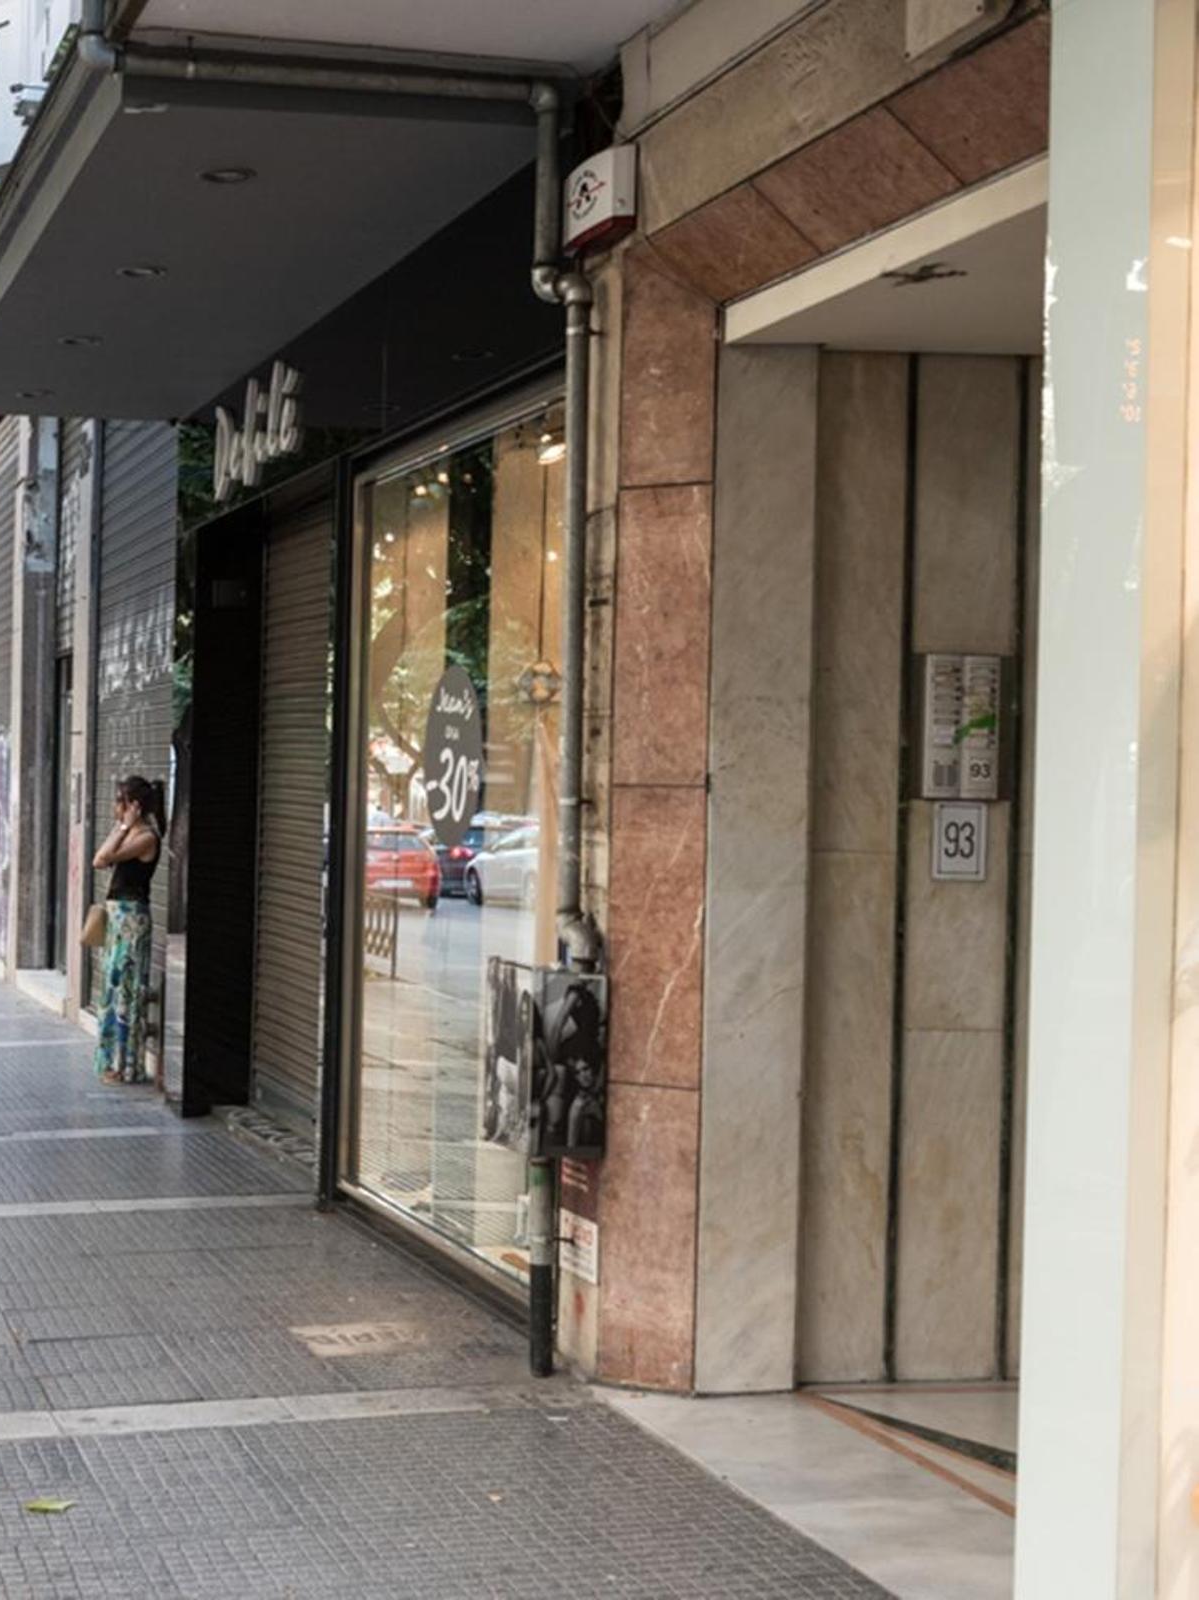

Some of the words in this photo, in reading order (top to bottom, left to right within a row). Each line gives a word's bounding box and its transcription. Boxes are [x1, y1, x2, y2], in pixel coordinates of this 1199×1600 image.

[426, 748, 481, 822] -30%
[970, 763, 991, 779] 93
[944, 821, 976, 859] 93
